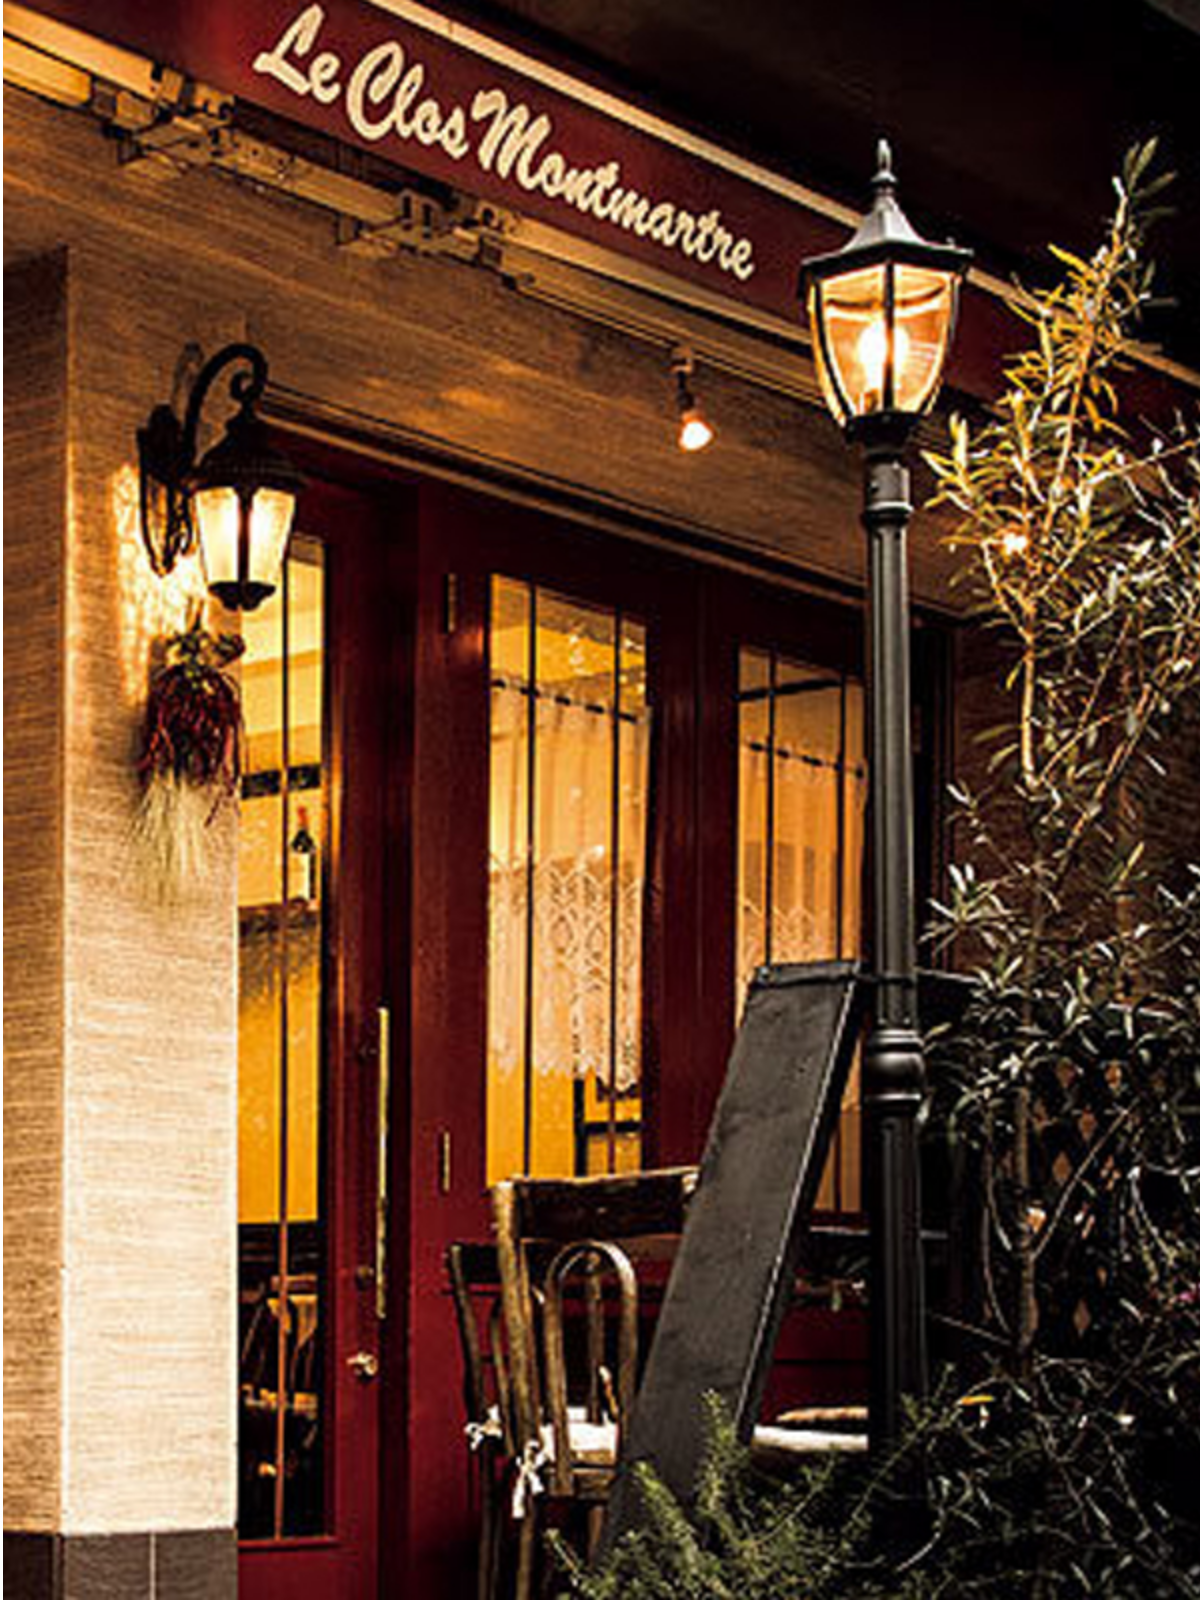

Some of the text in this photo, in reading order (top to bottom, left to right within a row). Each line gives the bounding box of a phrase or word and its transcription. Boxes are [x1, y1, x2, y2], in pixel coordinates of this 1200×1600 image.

[253, 4, 755, 280] Le Clos Montmartre
